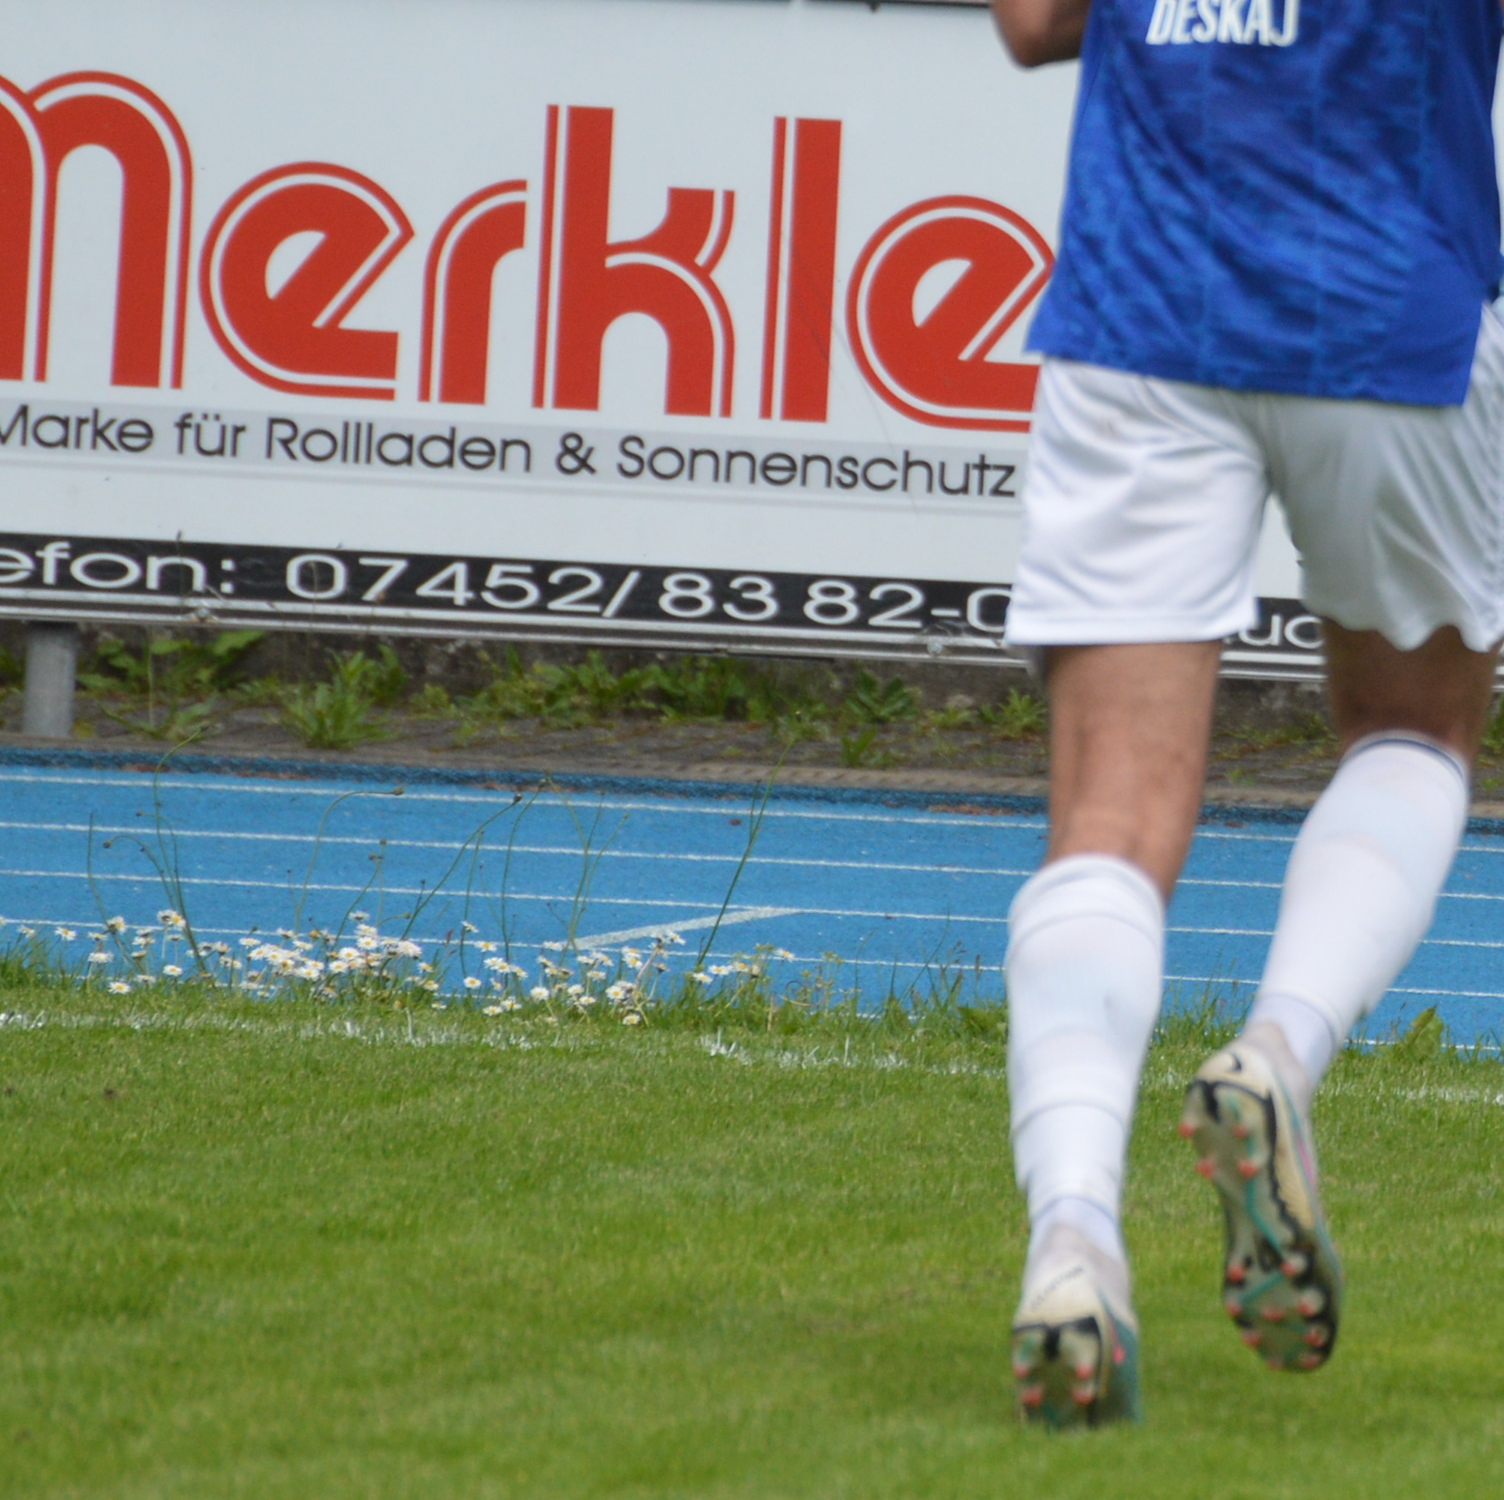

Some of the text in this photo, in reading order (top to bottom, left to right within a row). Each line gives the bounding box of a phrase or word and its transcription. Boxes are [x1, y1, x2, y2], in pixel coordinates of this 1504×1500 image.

[174, 412, 248, 458] für
[265, 417, 532, 474] Rollladen
[555, 432, 598, 476] &
[617, 435, 1018, 498] Sonnenschutz
